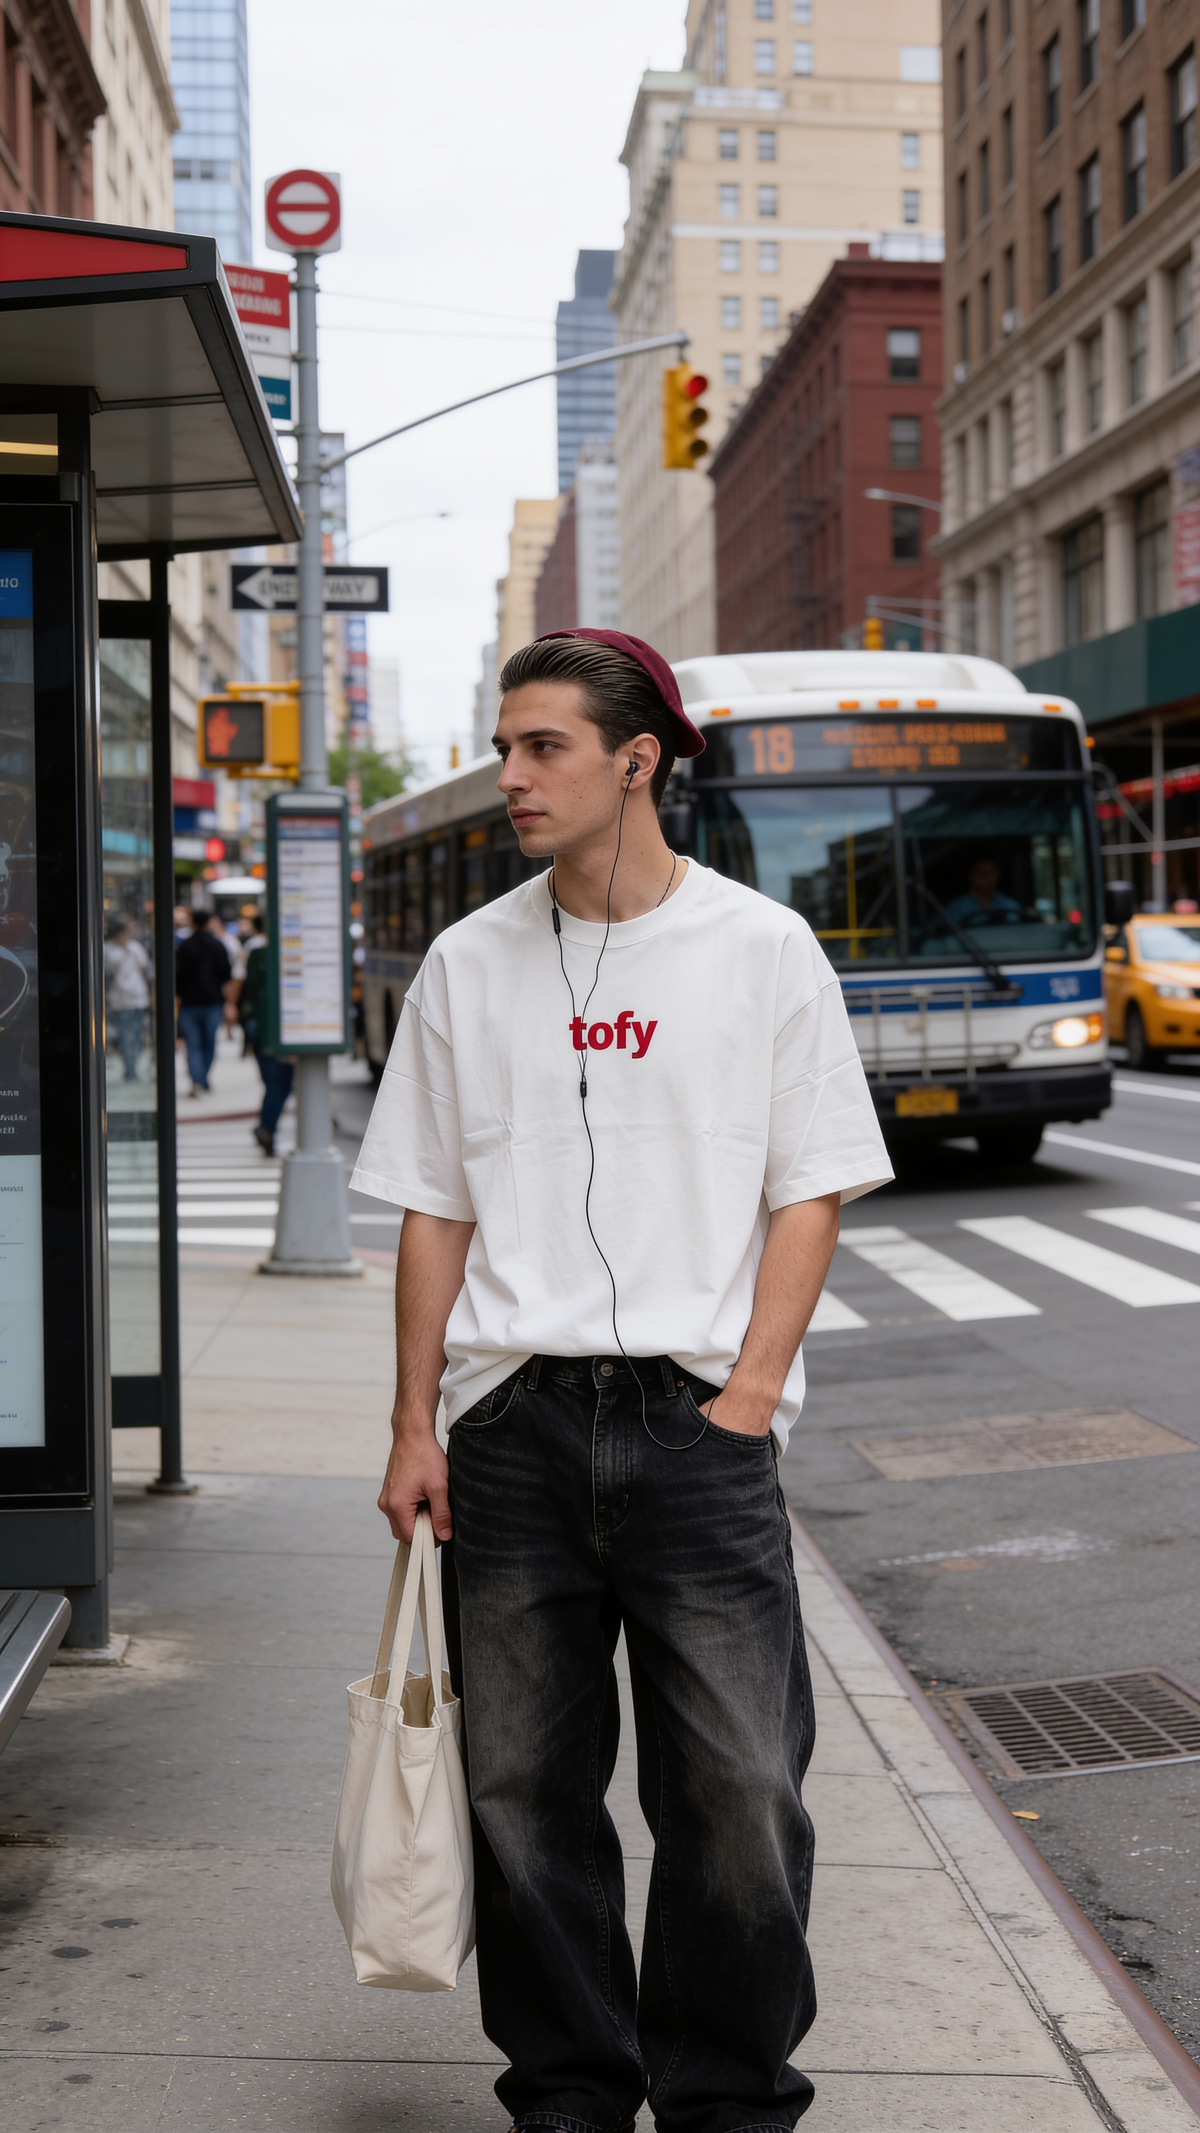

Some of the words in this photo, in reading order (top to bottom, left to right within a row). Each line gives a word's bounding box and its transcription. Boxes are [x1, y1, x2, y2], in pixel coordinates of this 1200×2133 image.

[259, 579, 294, 596] ONE
[328, 579, 366, 596] WAY
[747, 725, 795, 775] 18
[568, 1010, 659, 1060] tofy
